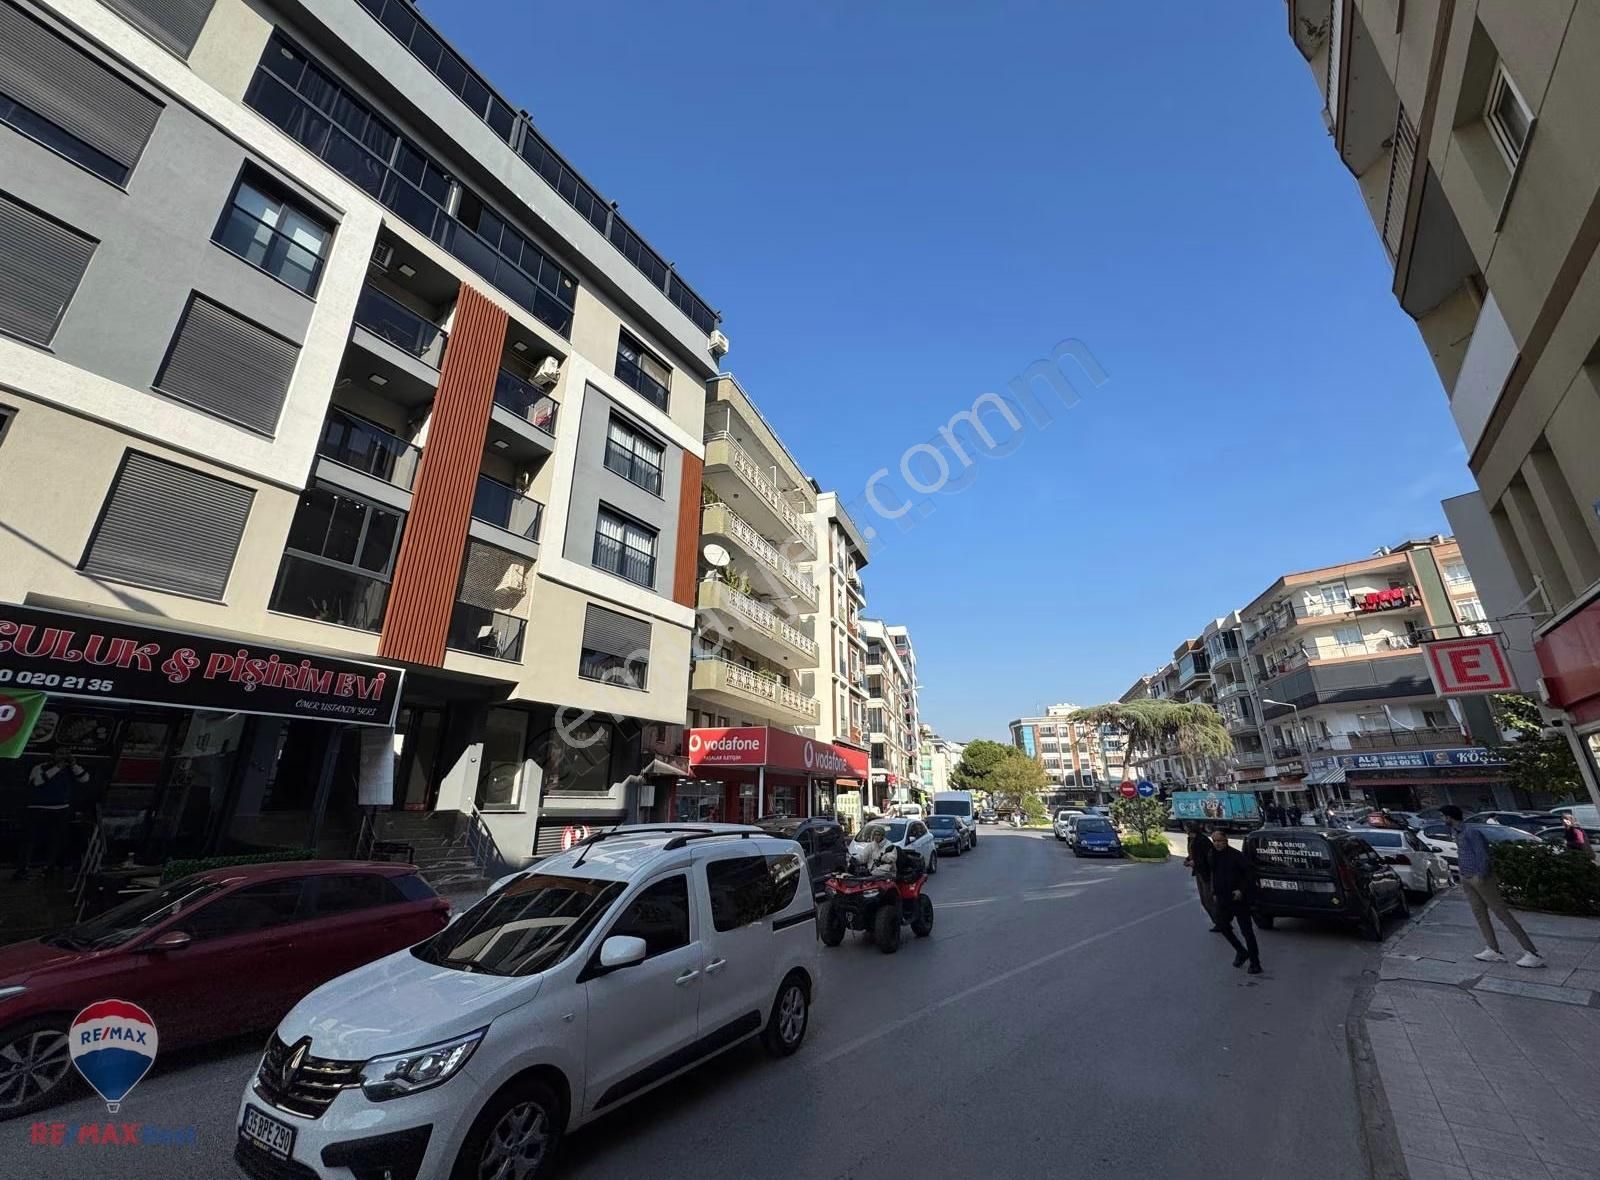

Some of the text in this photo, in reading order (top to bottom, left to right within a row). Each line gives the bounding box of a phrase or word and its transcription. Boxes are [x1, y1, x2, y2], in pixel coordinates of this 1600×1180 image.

[161, 648, 200, 683] &
[203, 649, 334, 694] PİŞİRİM
[333, 672, 387, 700] EVİ
[1448, 649, 1490, 684] E
[16, 671, 60, 686] 020
[62, 676, 86, 689] 21
[87, 679, 114, 691] 35
[703, 736, 760, 751] vodafone
[815, 750, 848, 772] vodafone
